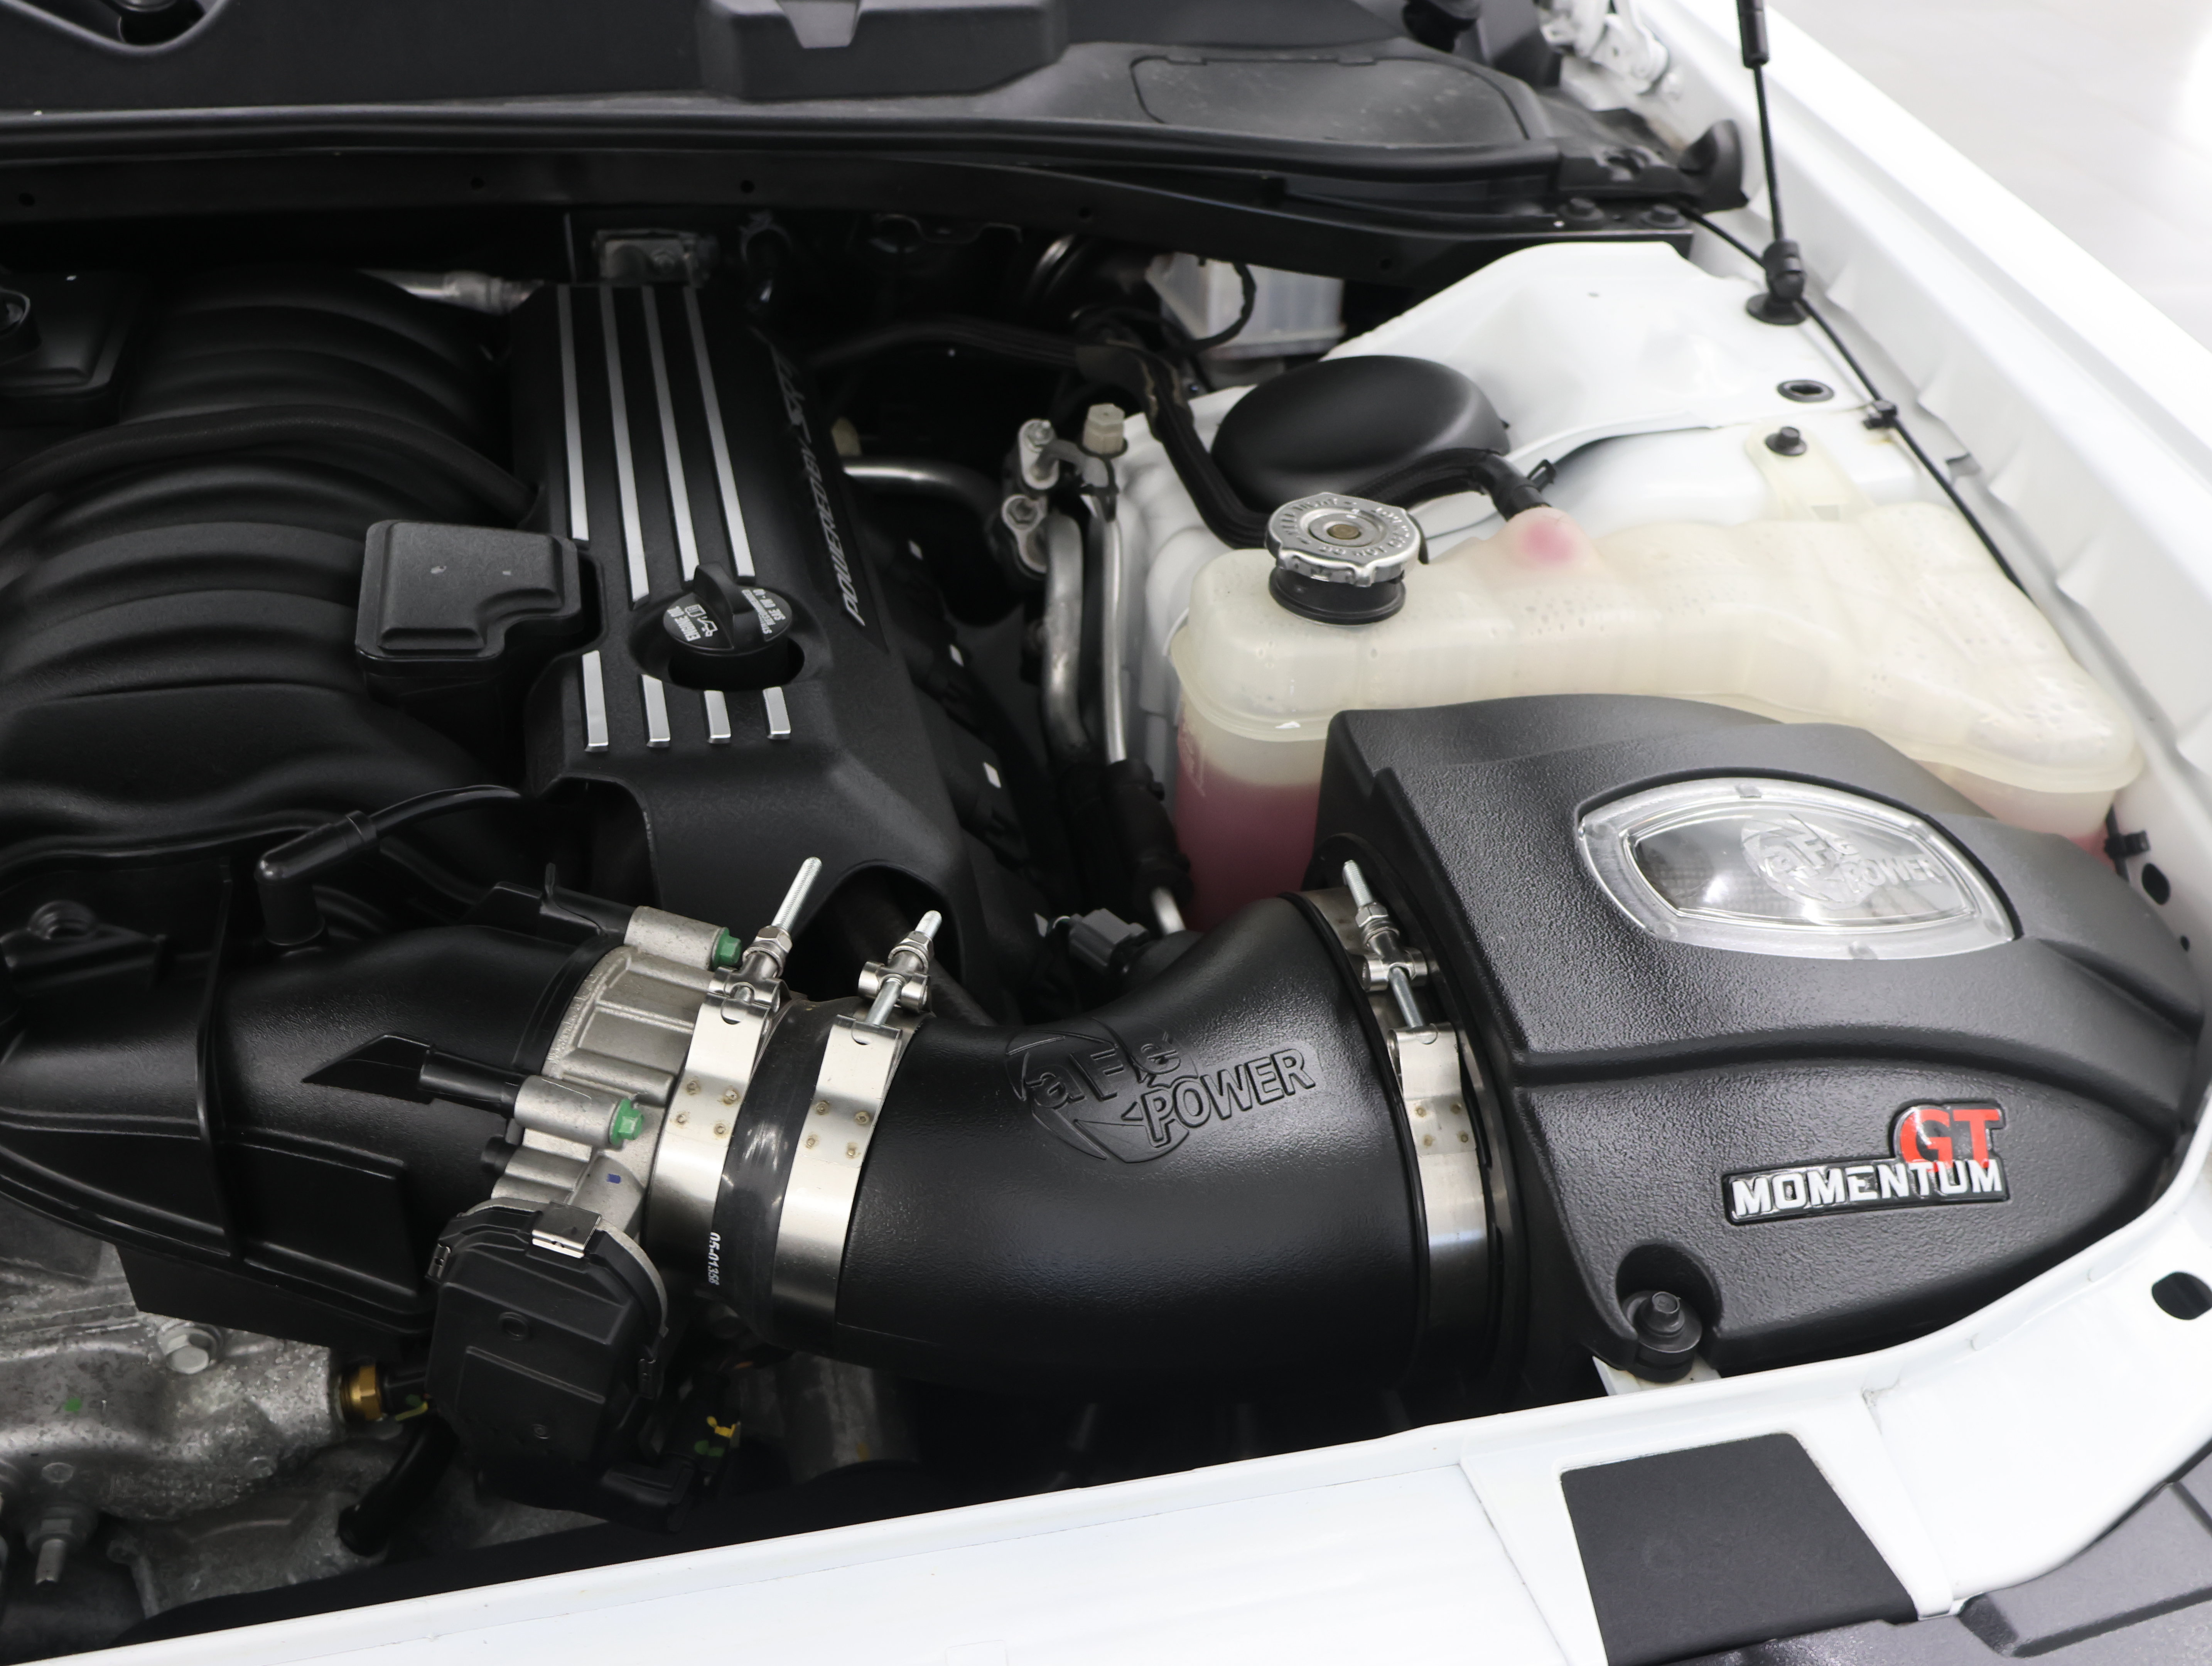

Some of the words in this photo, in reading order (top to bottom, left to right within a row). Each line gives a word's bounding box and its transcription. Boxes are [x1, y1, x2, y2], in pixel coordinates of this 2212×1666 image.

[797, 437, 822, 482] BY
[810, 477, 866, 626] POWERED
[1842, 853, 1946, 893] POWER
[1141, 1048, 1316, 1148] POWER
[1899, 1108, 2000, 1172] GT
[1731, 1159, 2003, 1216] MOMENTUM
